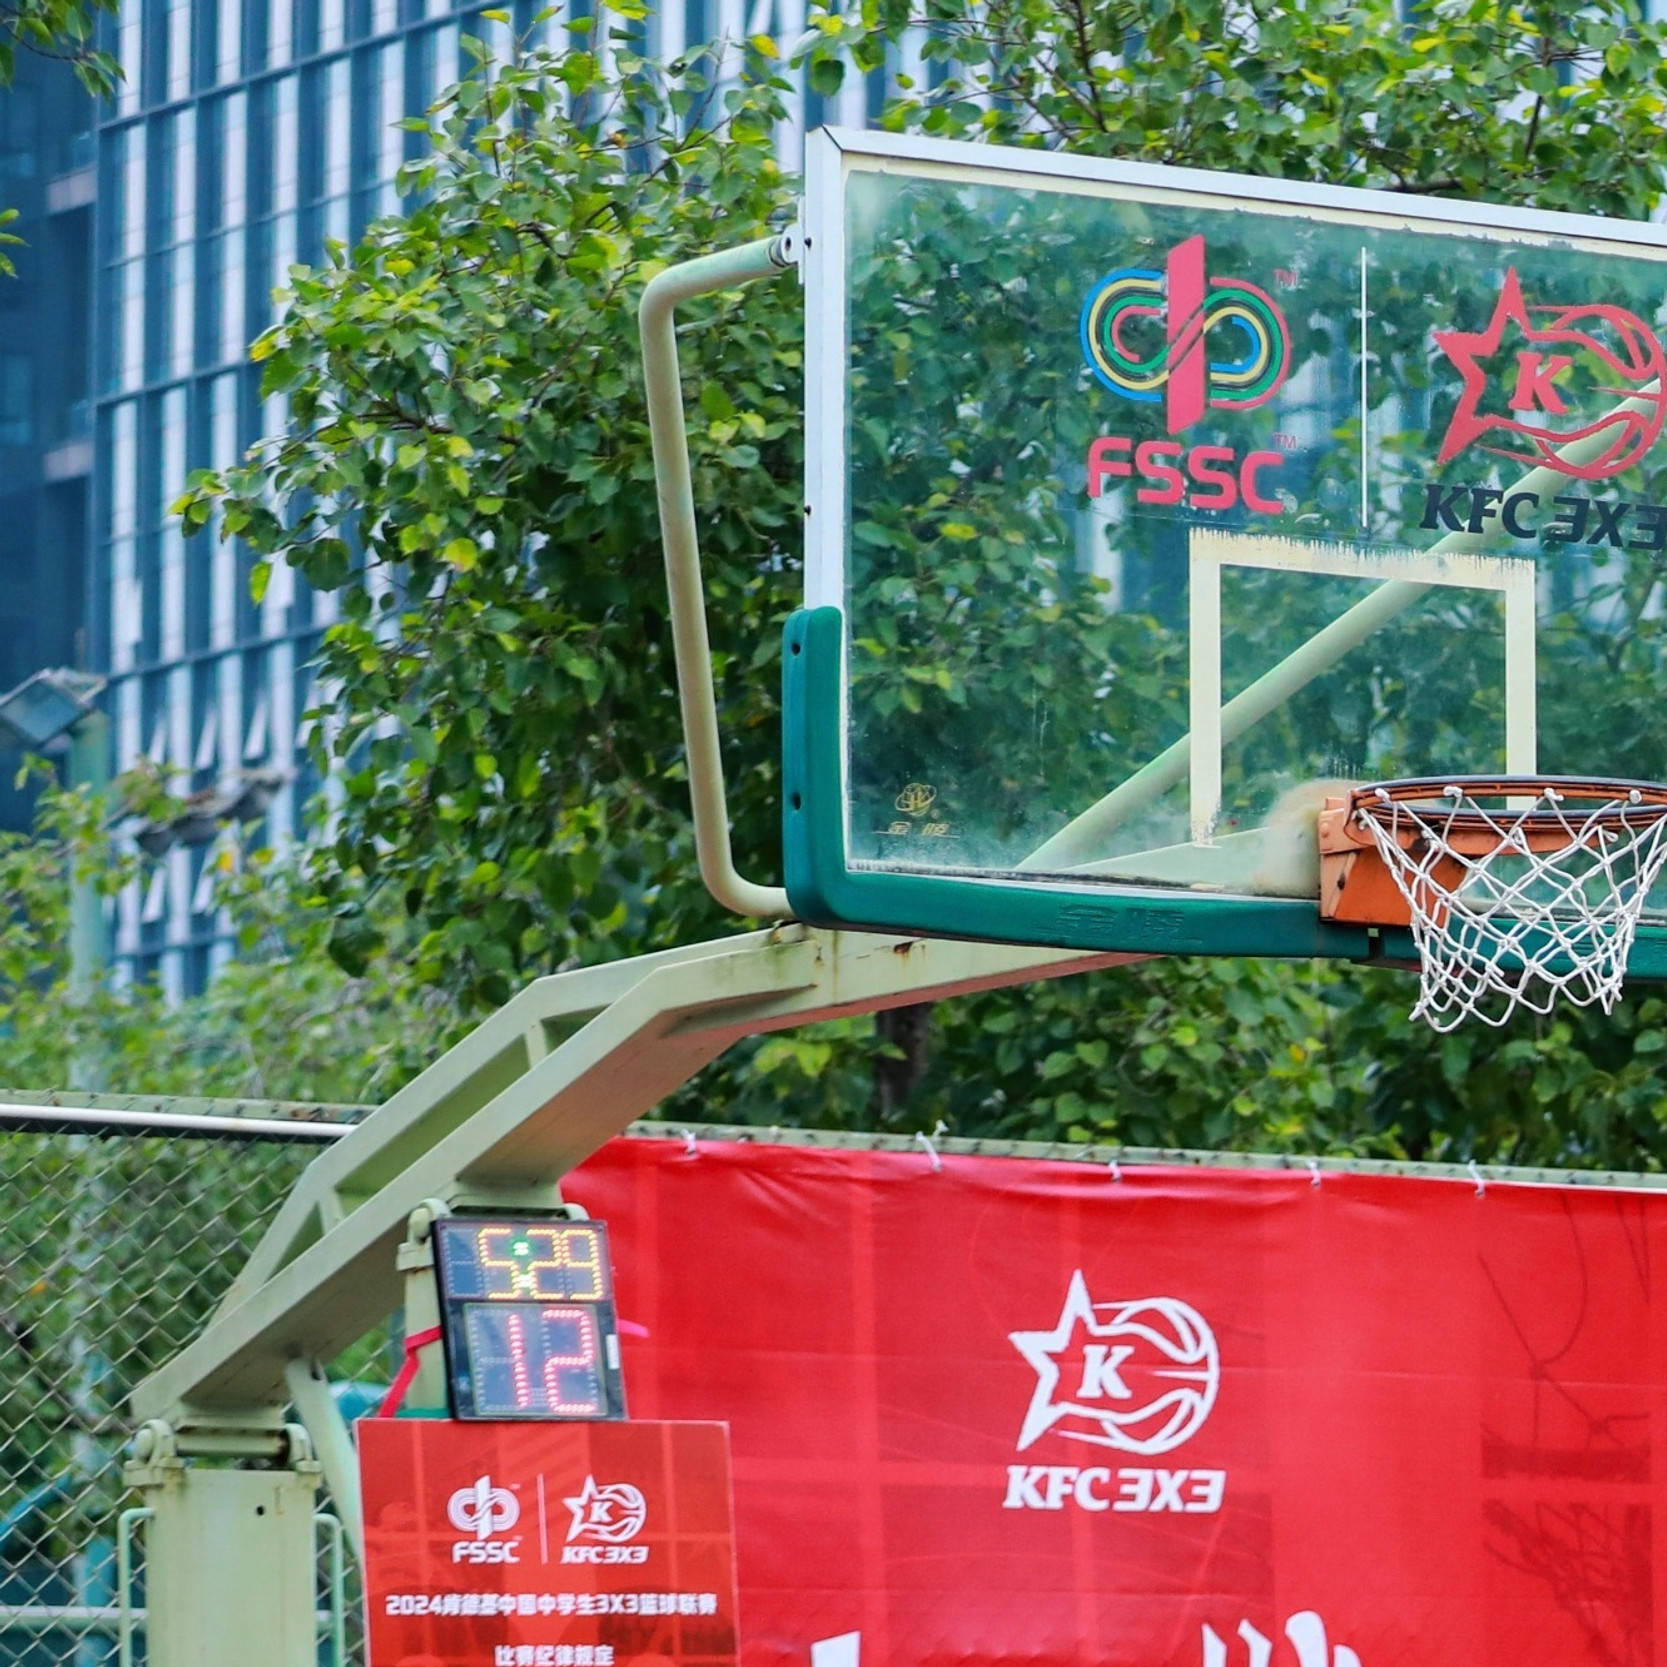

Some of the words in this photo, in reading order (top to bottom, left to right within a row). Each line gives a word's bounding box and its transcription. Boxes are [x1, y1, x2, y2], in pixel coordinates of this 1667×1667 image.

[1086, 435, 1285, 514] FSSC
[477, 1228, 604, 1301] 5:29
[508, 1308, 598, 1414] 12
[452, 1541, 519, 1564] FSSC
